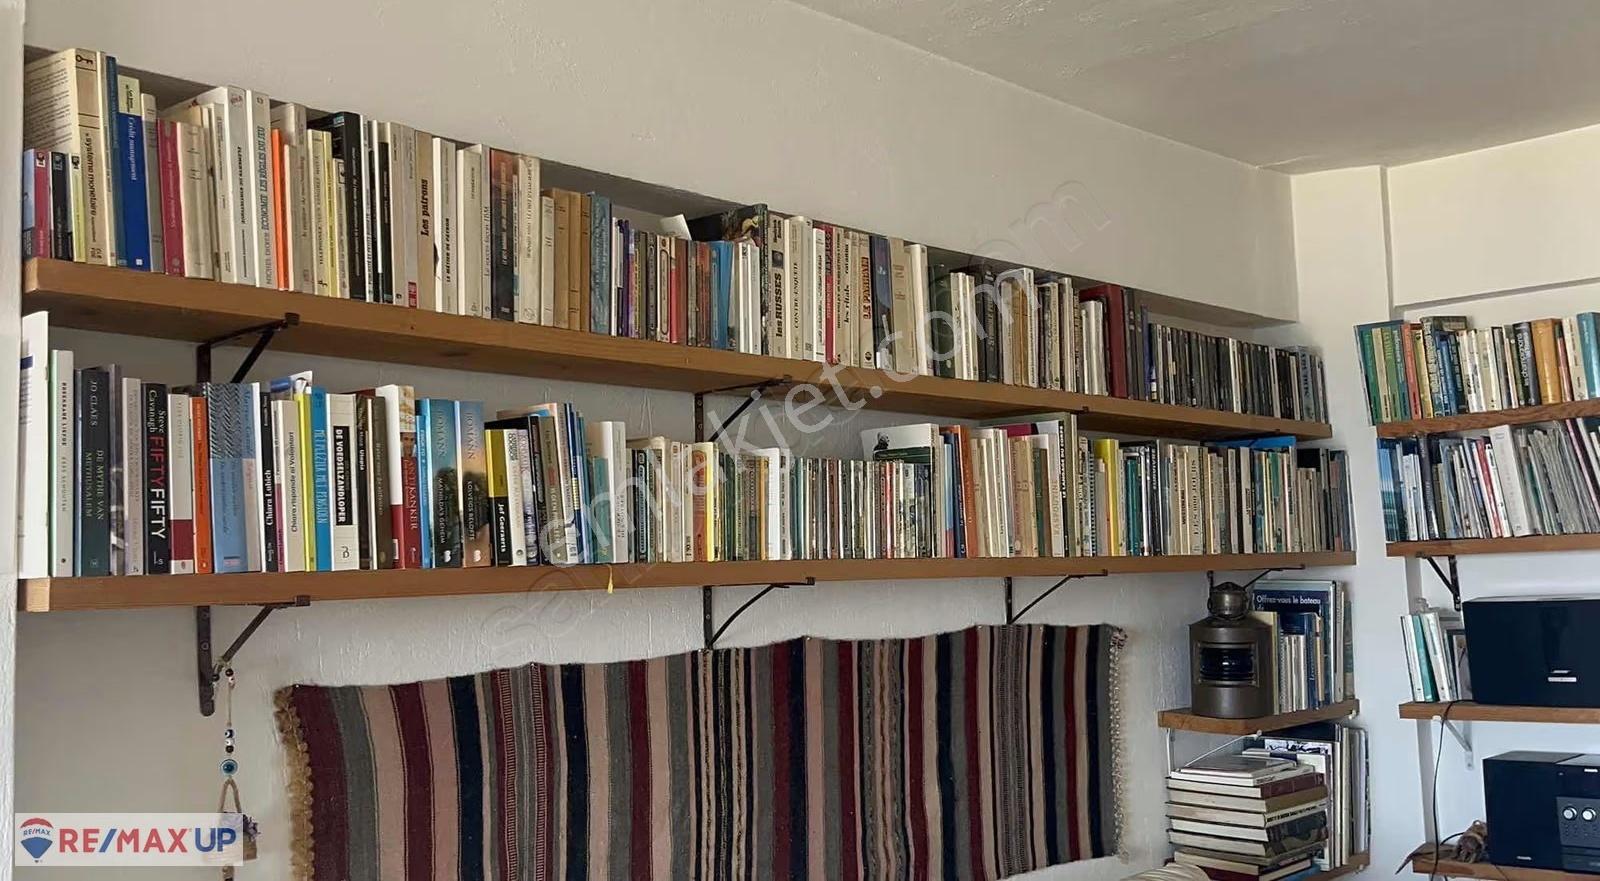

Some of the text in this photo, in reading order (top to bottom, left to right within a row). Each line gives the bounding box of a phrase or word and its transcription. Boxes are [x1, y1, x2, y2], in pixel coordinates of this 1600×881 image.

[256, 126, 266, 141] JEU
[257, 141, 266, 153] DU
[128, 139, 138, 181] management
[256, 153, 267, 179] RÈGLES
[258, 179, 268, 192] LES
[419, 178, 430, 236] Les patrons
[774, 273, 784, 338] les RUSSES
[861, 256, 871, 320] LE PARRAIN
[1516, 333, 1529, 378] champignons
[89, 380, 98, 427] JO CLAES
[146, 389, 157, 433] Cavanagh
[158, 409, 166, 433] Steve
[313, 429, 327, 444] MET
[465, 412, 476, 460] BOMANN
[1059, 447, 1065, 458] DU
[315, 474, 327, 488] MET
[335, 429, 347, 523] DE VOEDSELZANDLOPER
[358, 449, 366, 471] Utopia
[84, 451, 94, 518] METHUSALEM
[95, 449, 104, 521] DE MYTHE VAN
[263, 469, 274, 526] Chiara Lubich
[289, 479, 298, 508] risponde
[407, 459, 418, 530] ANTIKANKER
[290, 508, 298, 533] Chiara
[316, 490, 329, 524] PENSIOEN
[437, 477, 446, 544] MATHILDA'S GEHEIM
[497, 503, 507, 553] Jef Geeraerts
[1256, 595, 1321, 605] Offrez-vous le bateau
